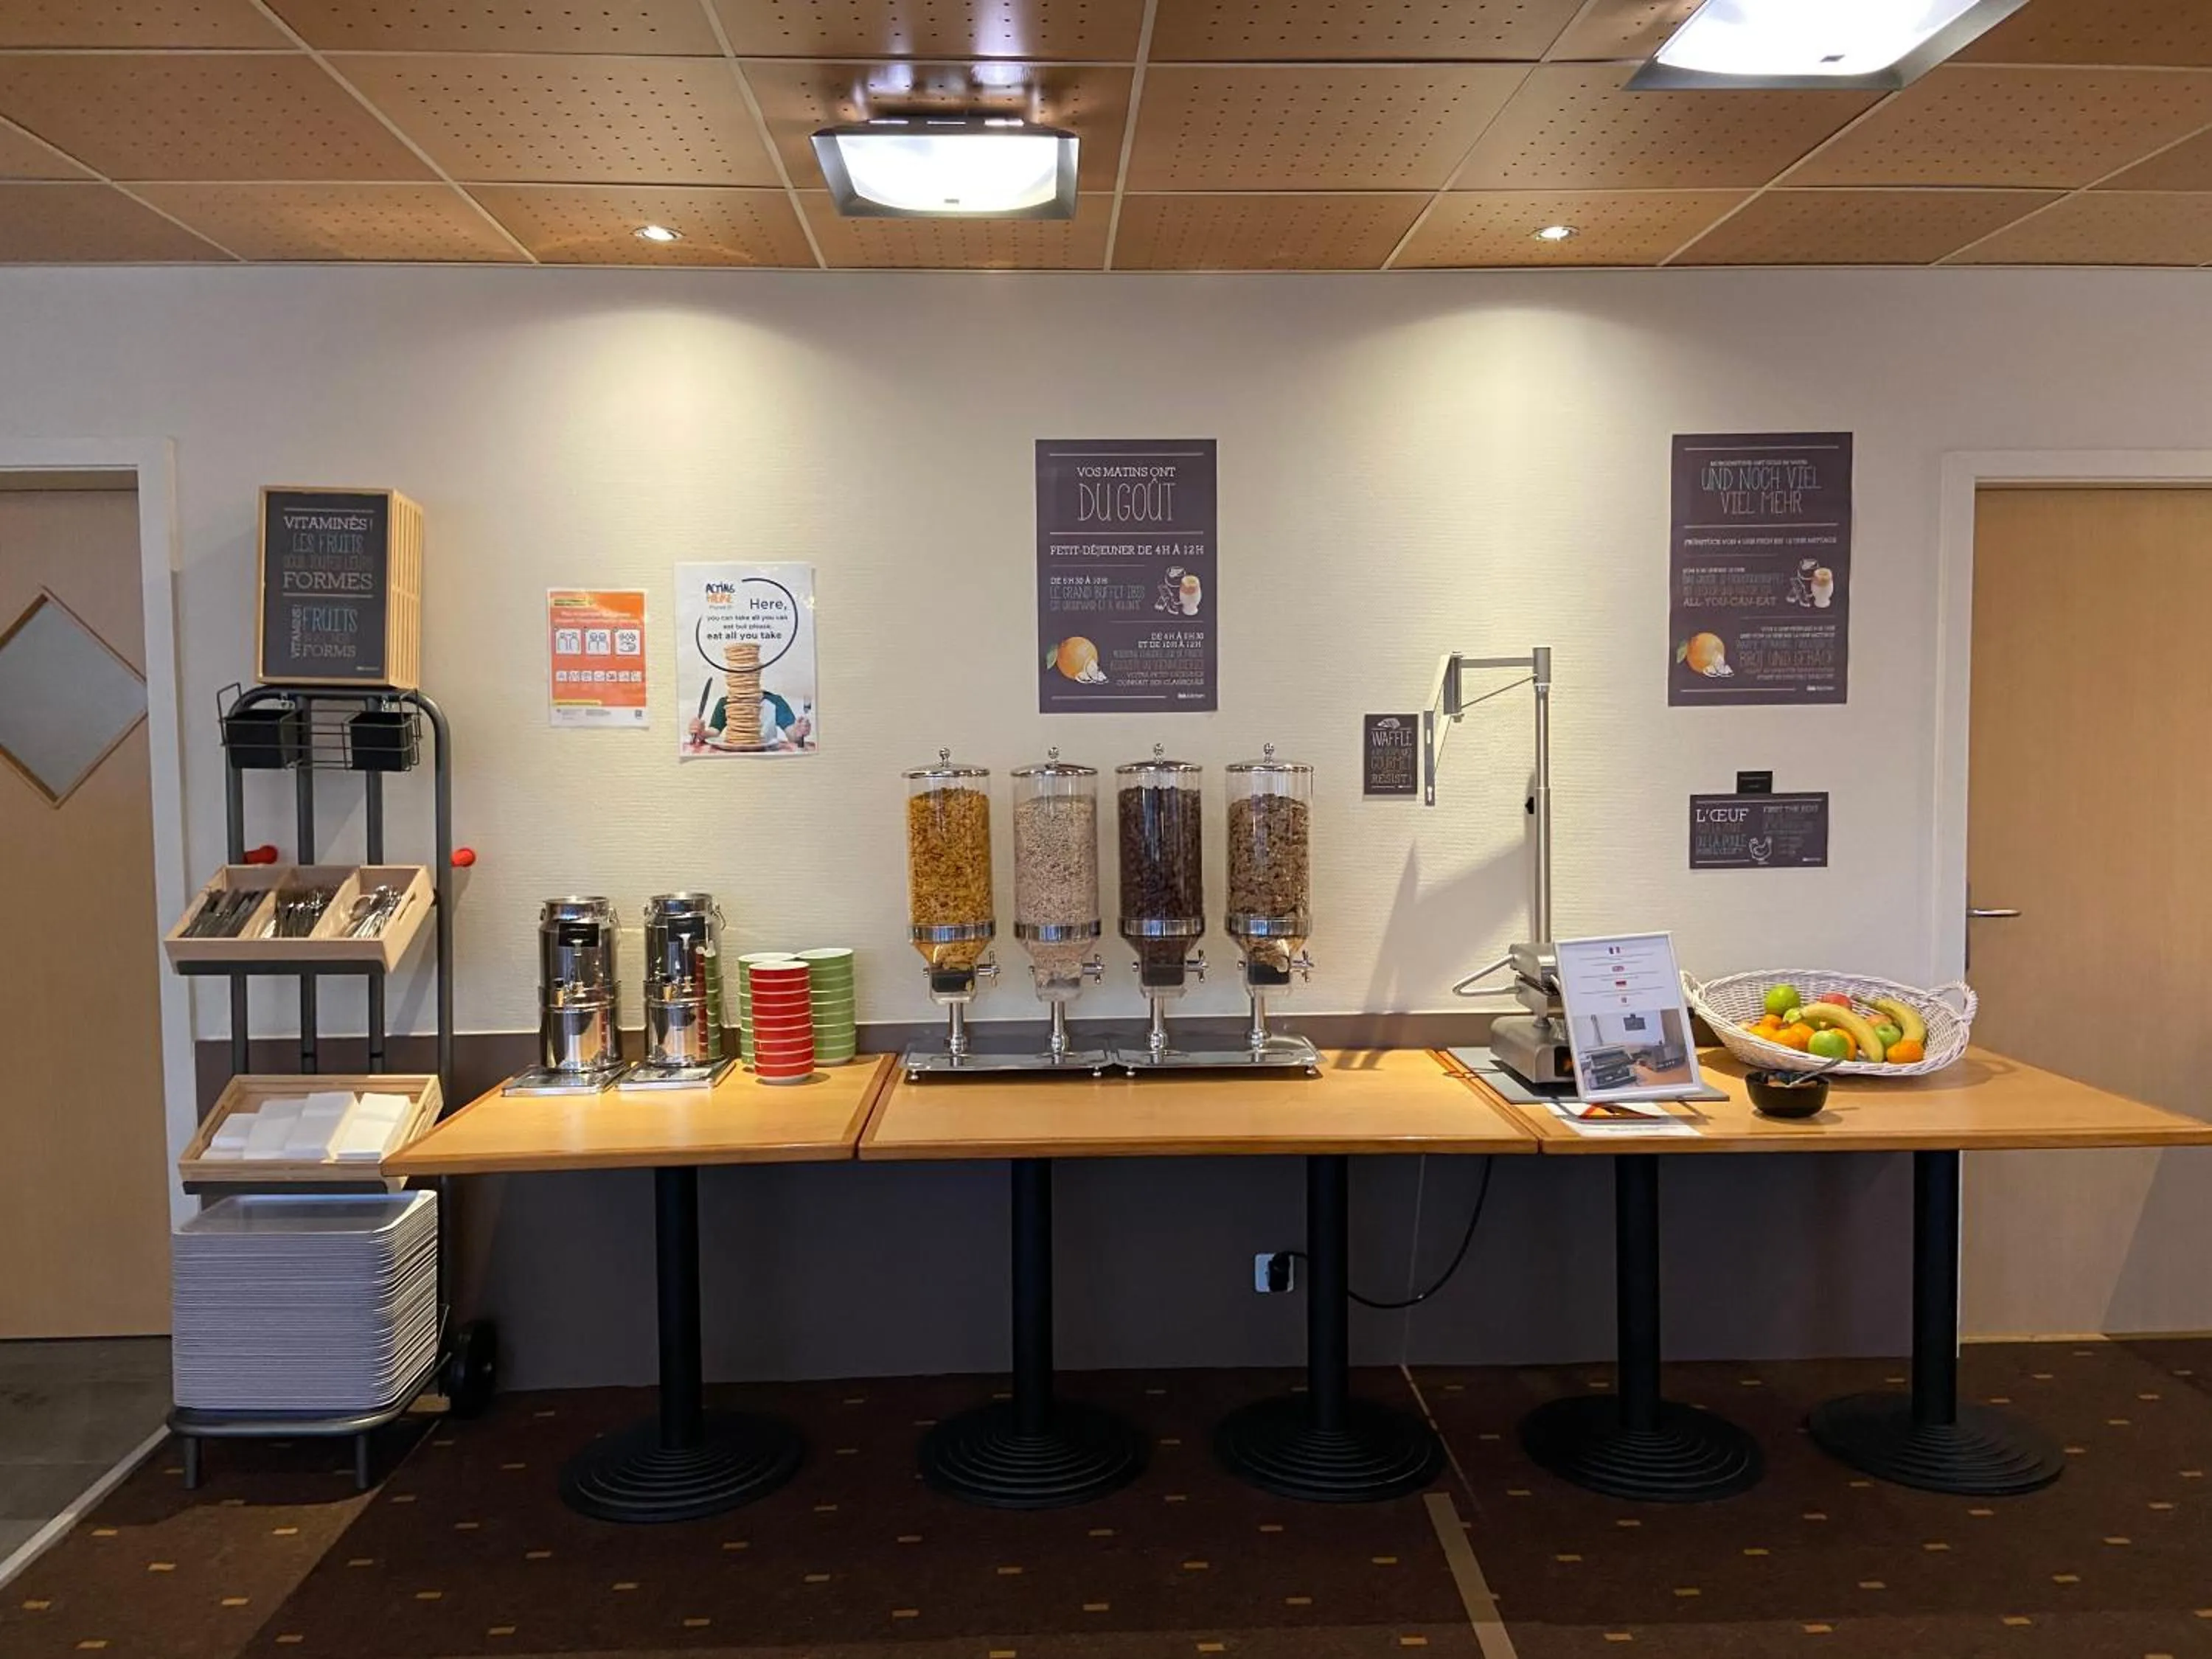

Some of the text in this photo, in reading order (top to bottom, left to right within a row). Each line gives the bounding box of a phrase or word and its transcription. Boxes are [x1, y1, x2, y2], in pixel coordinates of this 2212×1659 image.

[1077, 467, 1175, 477] VOS MATINS ONT
[1077, 478, 1177, 521] DU GOÛT
[1138, 546, 1152, 554] DE
[282, 571, 374, 589] FORMES
[750, 598, 787, 611] Here,
[726, 631, 737, 639] all
[740, 633, 758, 641] you
[760, 631, 782, 640] take
